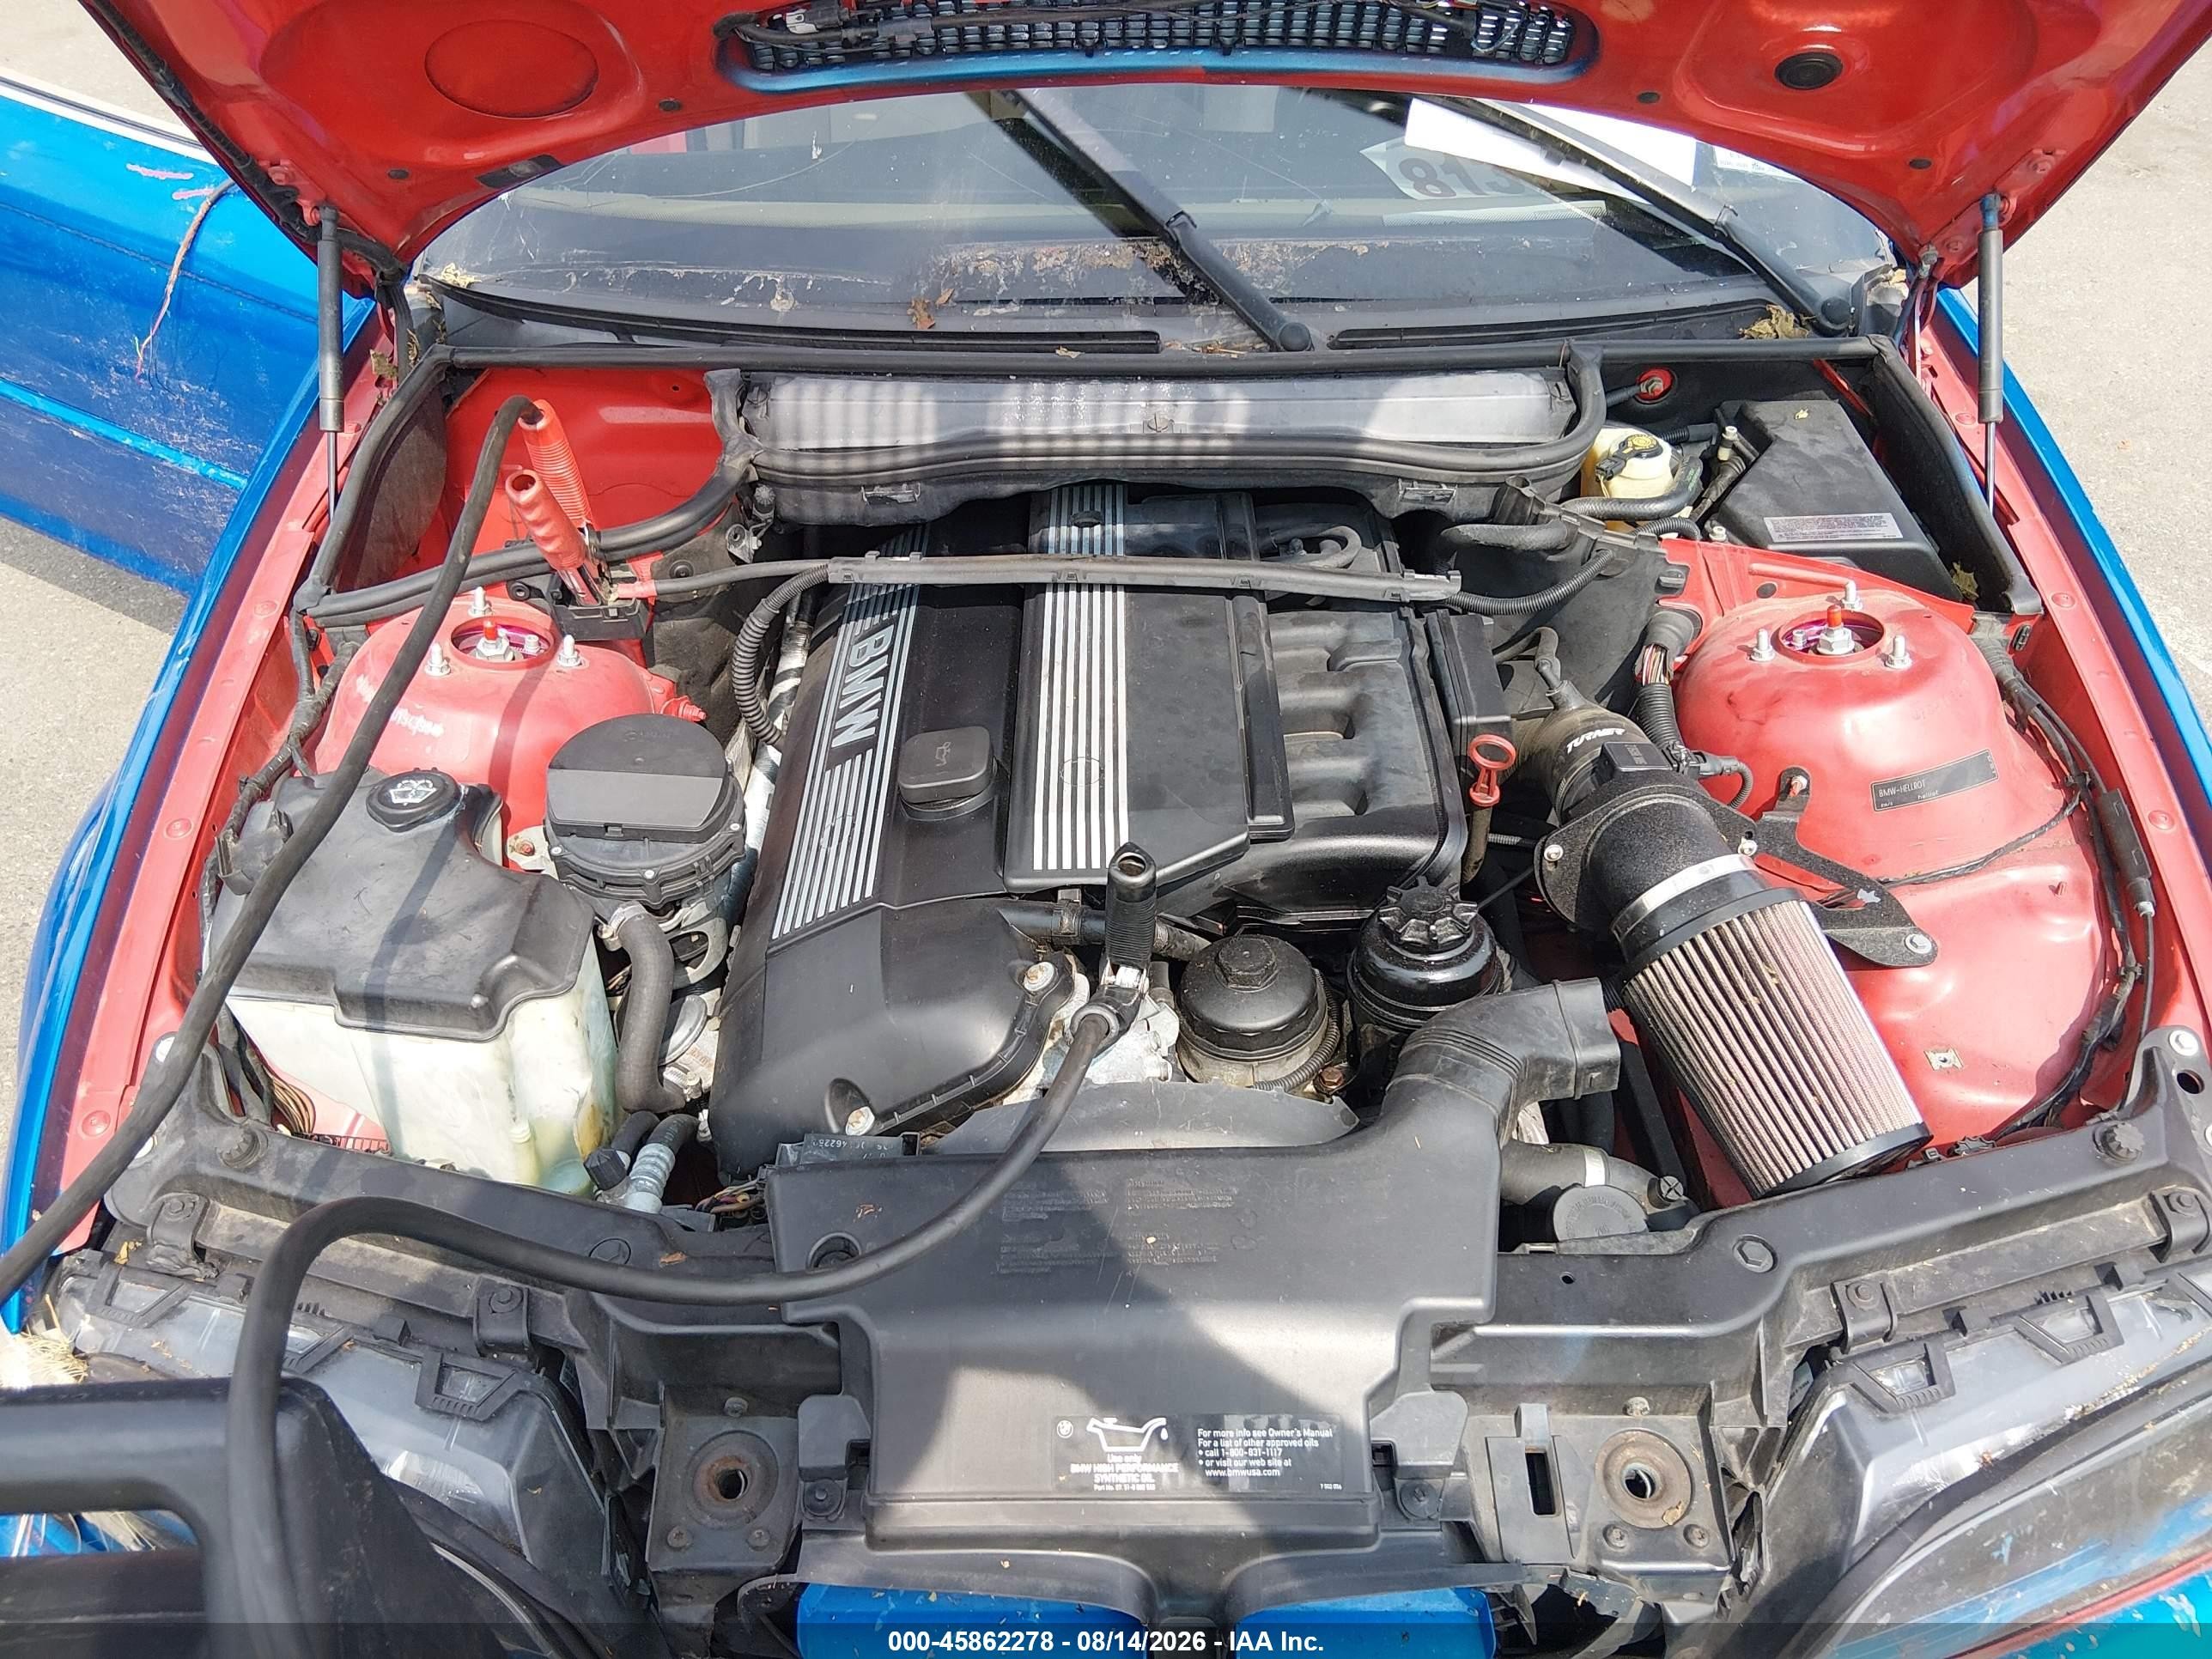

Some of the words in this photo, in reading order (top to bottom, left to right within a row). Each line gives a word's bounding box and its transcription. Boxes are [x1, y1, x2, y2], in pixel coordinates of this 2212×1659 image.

[831, 624, 895, 748] BMW
[1879, 779, 1926, 798] BMW-HELLROT
[1197, 1428, 1211, 1437] For
[1212, 1428, 1234, 1437] more
[1236, 1428, 1250, 1437] info
[1252, 1428, 1267, 1437] see
[1268, 1428, 1302, 1437] Owner's
[1303, 1428, 1333, 1437] Manual
[1198, 1438, 1212, 1447] For
[1220, 1438, 1233, 1447] list
[1234, 1438, 1243, 1447] of
[1243, 1438, 1264, 1447] other
[1266, 1438, 1303, 1449] approved
[1304, 1438, 1319, 1447] oils
[1205, 1449, 1218, 1457] call
[1221, 1449, 1282, 1457] 1-800-831-1117
[1205, 1458, 1213, 1467] or
[1216, 1458, 1232, 1467] visit
[1234, 1458, 1247, 1467] our
[1249, 1458, 1266, 1467] web
[1267, 1458, 1282, 1467] site
[1284, 1458, 1291, 1467] at
[1205, 1468, 1280, 1477] www.bmwusa.com
